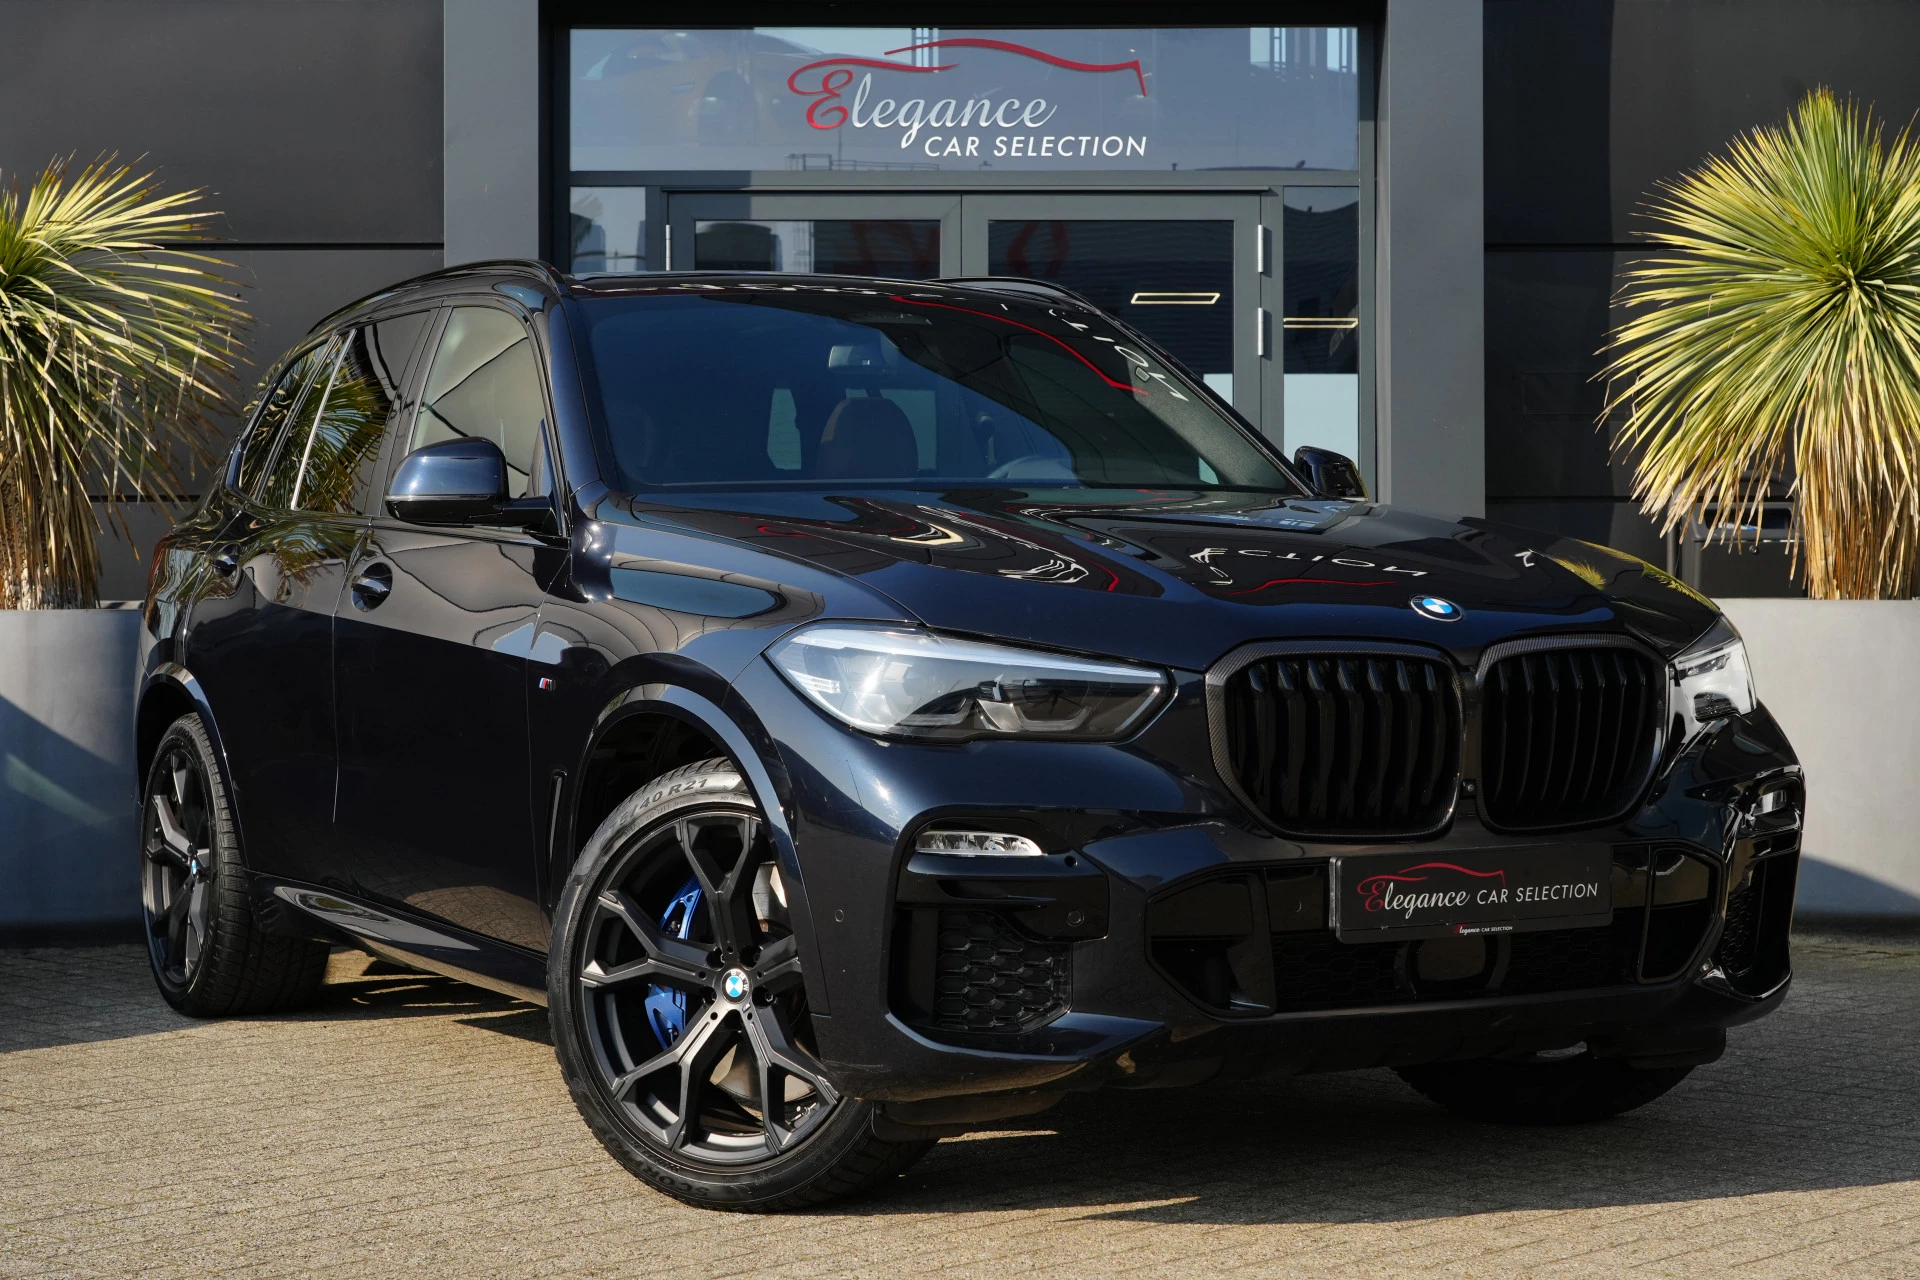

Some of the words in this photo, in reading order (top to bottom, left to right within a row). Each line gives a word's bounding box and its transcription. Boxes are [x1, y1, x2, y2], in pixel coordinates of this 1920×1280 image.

[787, 57, 1058, 149] Elegance
[924, 135, 980, 157] CAR
[993, 135, 1147, 157] SELECTION
[667, 778, 708, 796] R21
[1357, 875, 1471, 920] Elegance
[1477, 887, 1509, 905] CAR
[1515, 882, 1599, 903] SELECTION
